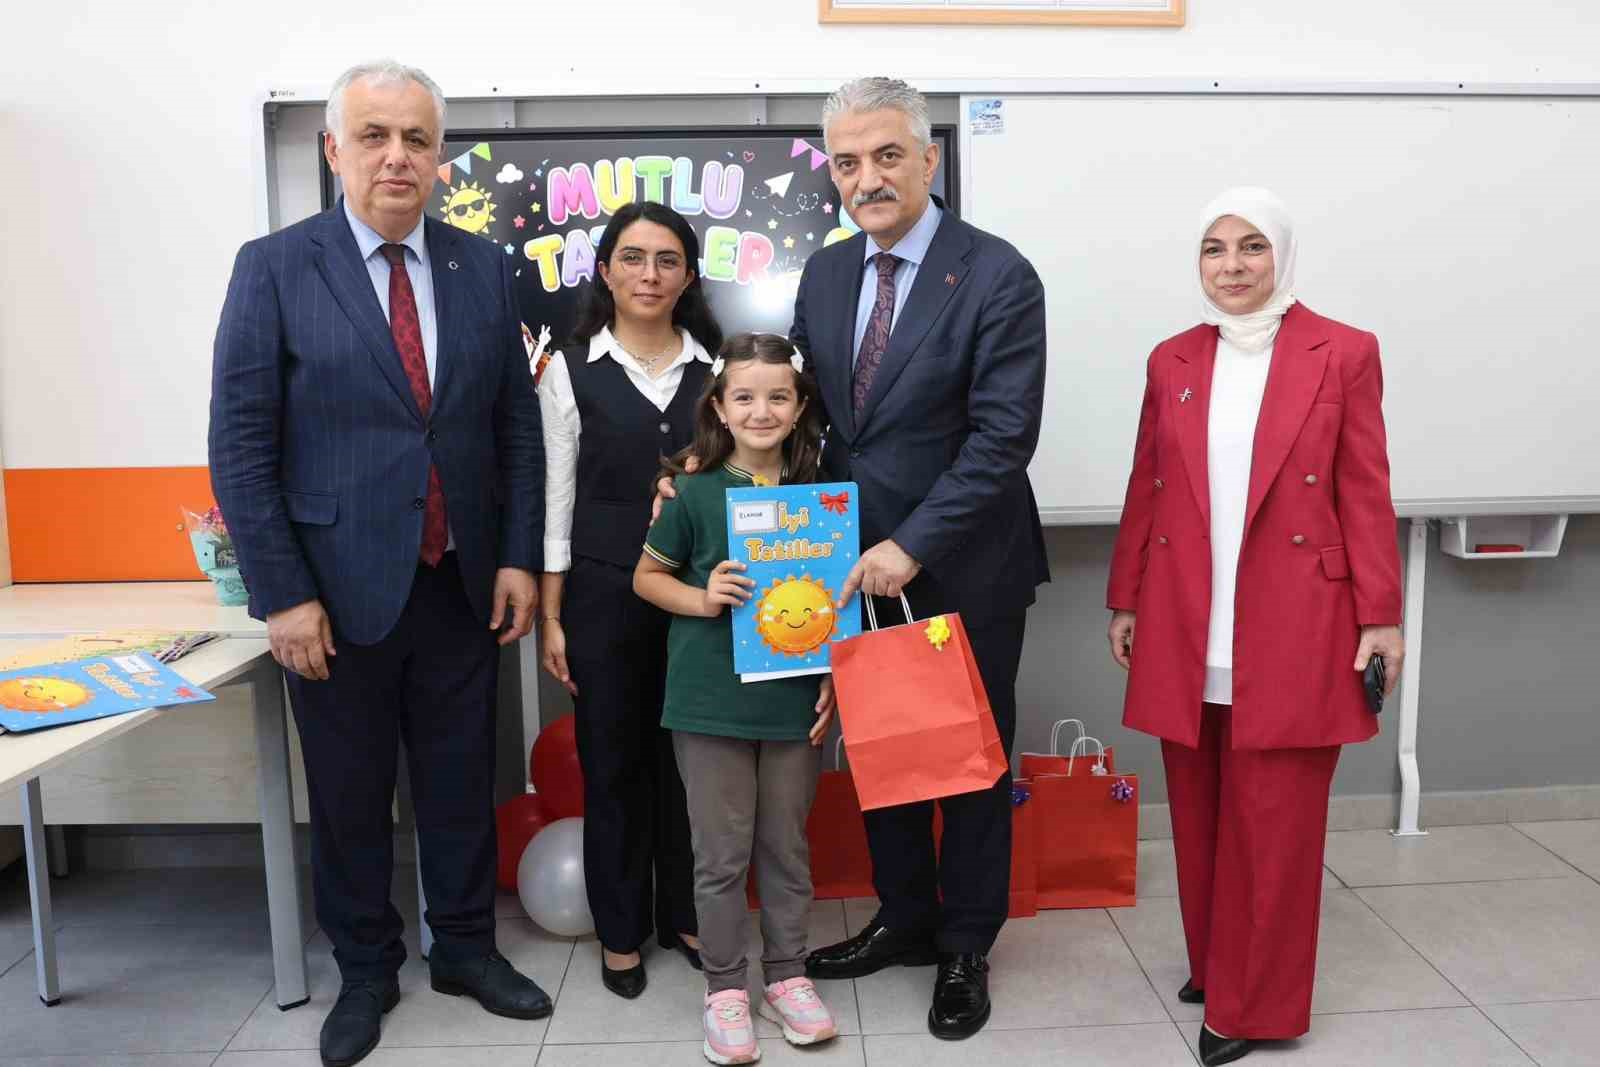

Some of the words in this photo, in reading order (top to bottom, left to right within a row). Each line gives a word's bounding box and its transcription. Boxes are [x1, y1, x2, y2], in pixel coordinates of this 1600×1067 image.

[548, 156, 744, 225] MUTLU
[524, 226, 774, 292] TAER
[746, 539, 833, 561] Tatiller
